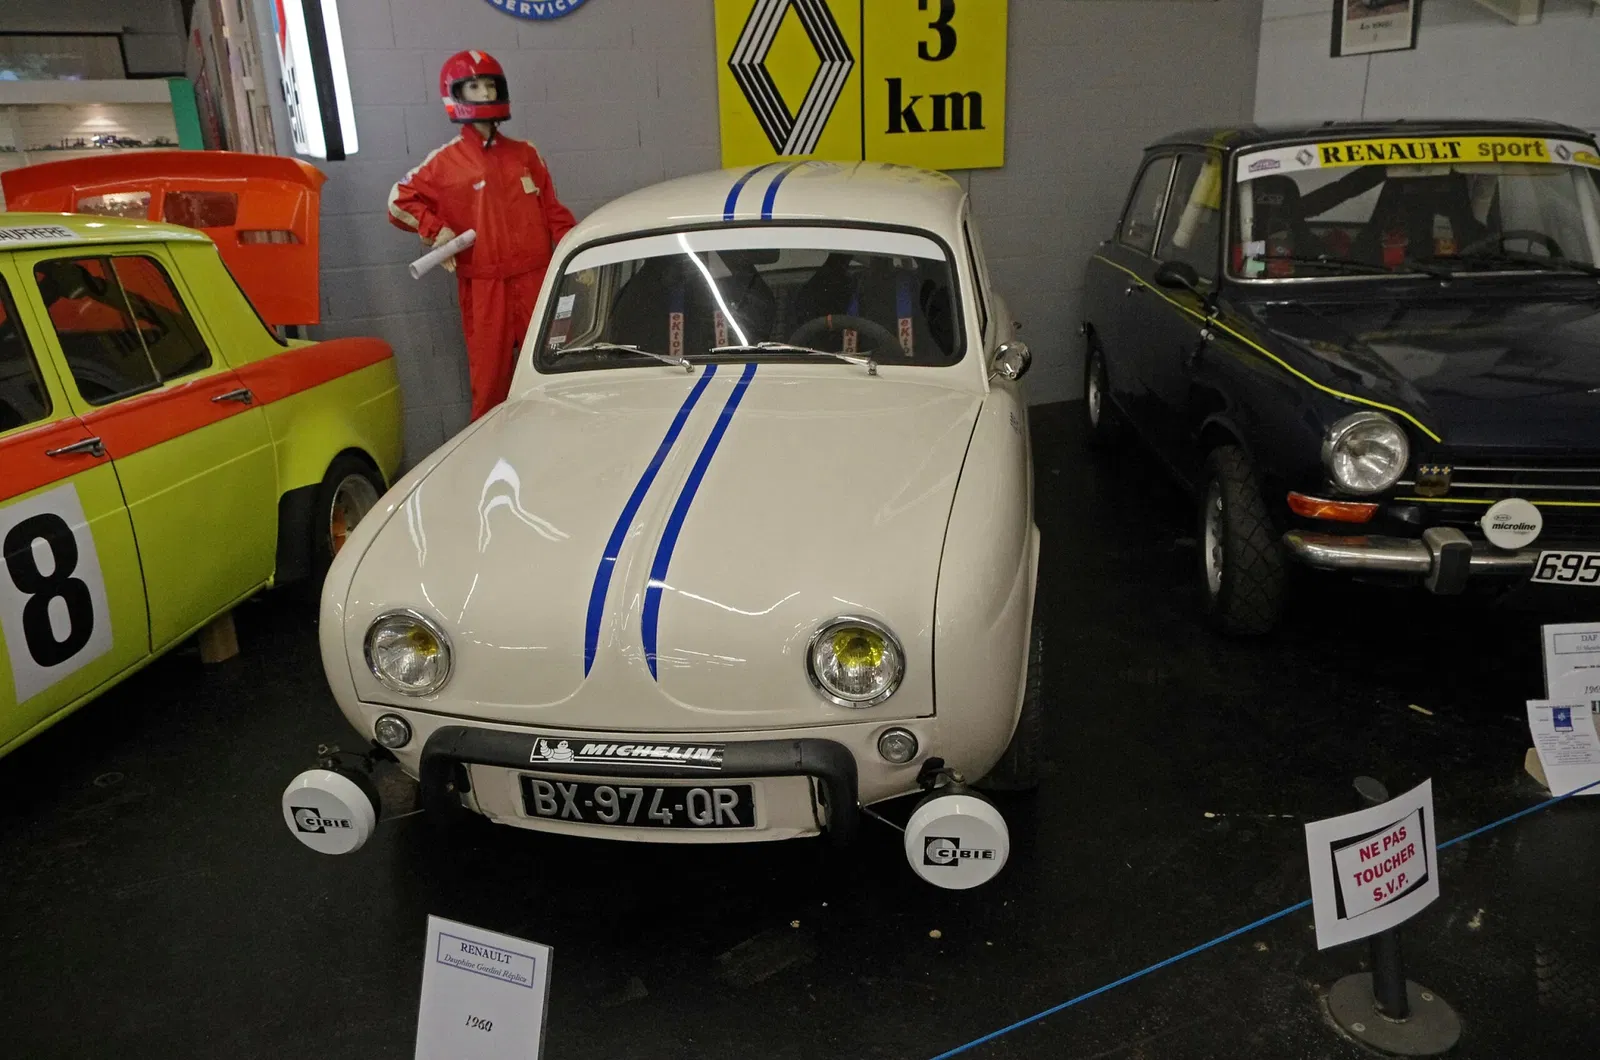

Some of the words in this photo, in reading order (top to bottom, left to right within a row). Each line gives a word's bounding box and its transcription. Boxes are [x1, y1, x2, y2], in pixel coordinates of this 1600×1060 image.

[917, 0, 957, 62] 3
[884, 77, 986, 135] km
[1321, 141, 1462, 164] RENAULT
[1477, 139, 1545, 162] sport
[1492, 521, 1537, 532] microline
[1536, 553, 1600, 584] 695
[3, 512, 94, 668] 8
[1580, 634, 1598, 643] DAF
[1584, 684, 1600, 696] 196
[579, 743, 717, 761] MICHELIN
[531, 779, 741, 826] BX-974-QR
[1358, 841, 1381, 863] NE
[1382, 825, 1408, 851] PAS
[1353, 842, 1416, 887] TOUCHER
[1373, 872, 1409, 902] S.V.P.
[444, 953, 476, 970] Dauphine
[476, 963, 502, 977] Gordini
[460, 942, 512, 965] RENAULT
[465, 1014, 493, 1033] 1960
